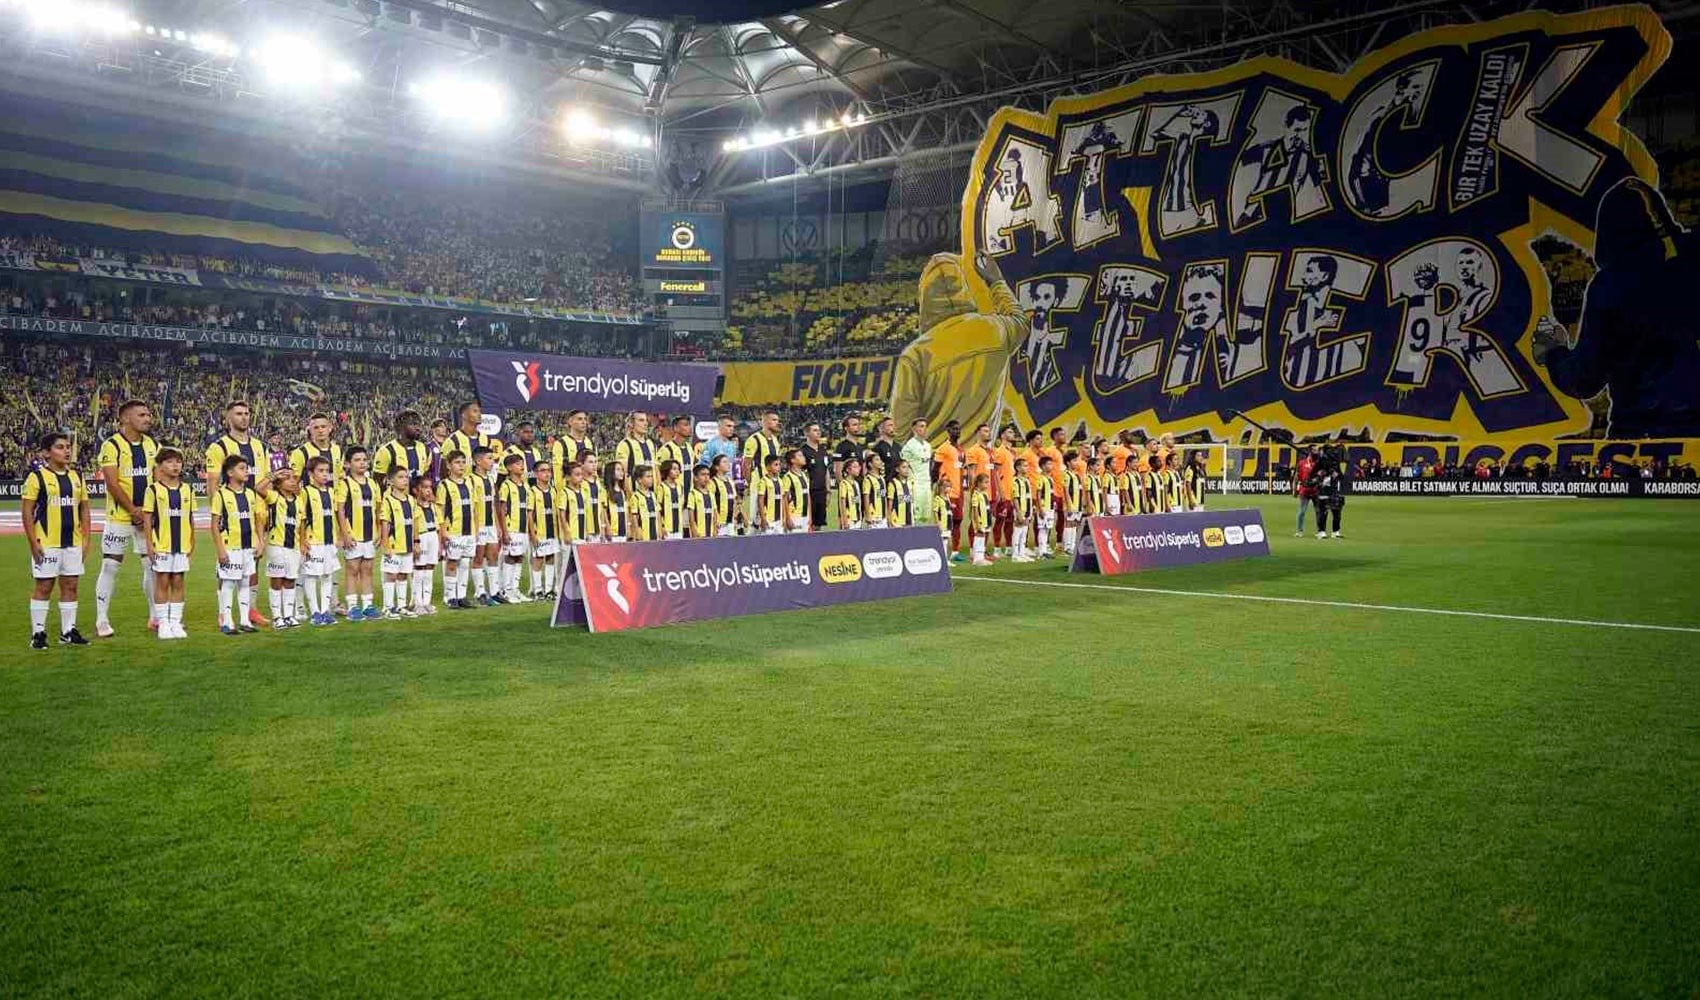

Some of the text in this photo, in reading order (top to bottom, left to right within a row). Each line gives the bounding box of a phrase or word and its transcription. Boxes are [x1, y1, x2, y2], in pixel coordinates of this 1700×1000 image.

[1469, 103, 1495, 142] UZAY
[982, 41, 1605, 257] ATTACK
[1462, 146, 1485, 173] TEK
[1017, 237, 1528, 399] FENER
[1409, 317, 1428, 350] 9
[544, 369, 628, 399] trendyol
[1352, 481, 1398, 492] KARABORSA
[1400, 480, 1421, 492] BİLET
[1423, 481, 1457, 492] SATMAK
[1459, 481, 1473, 492] VE
[1472, 482, 1502, 493] ALMAK
[1542, 482, 1565, 495] SUÇA
[1567, 482, 1597, 493] ORTAK
[1122, 531, 1168, 552] trendyol
[643, 562, 741, 593] trendyol
[824, 561, 858, 577] NESİNE
